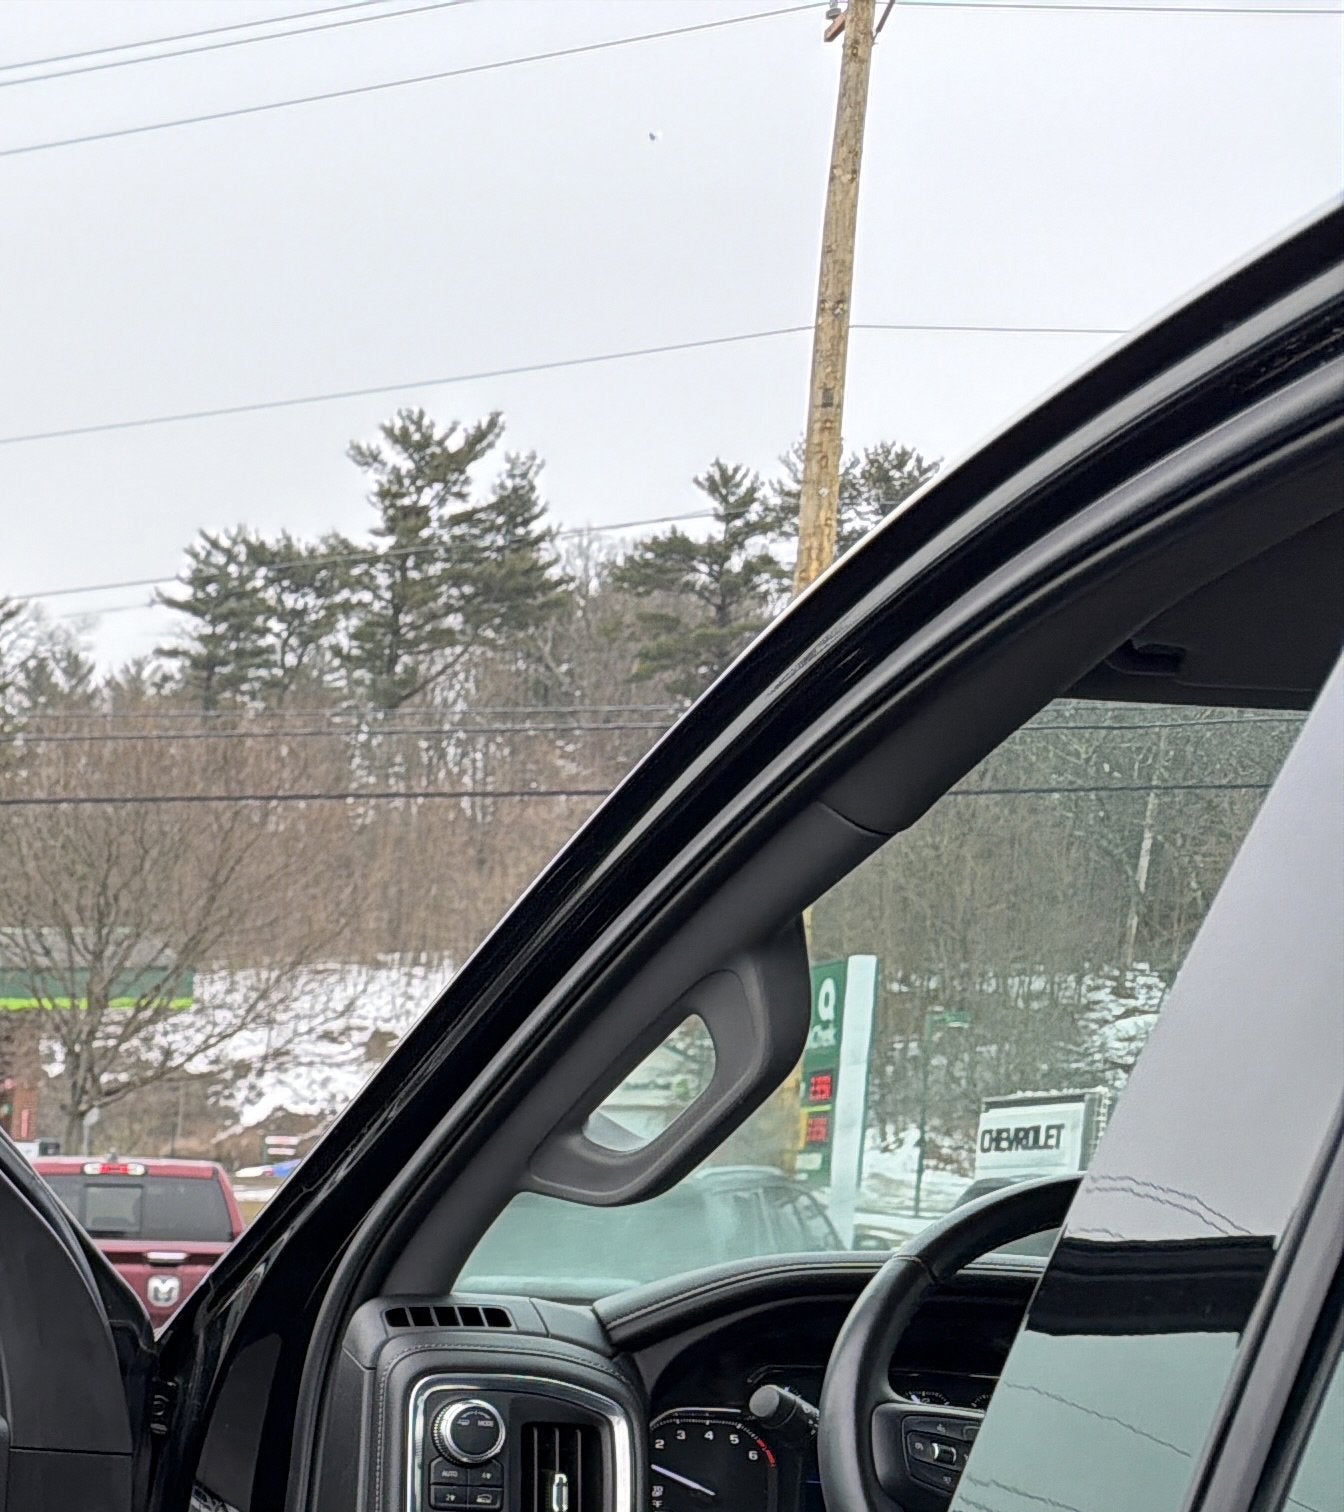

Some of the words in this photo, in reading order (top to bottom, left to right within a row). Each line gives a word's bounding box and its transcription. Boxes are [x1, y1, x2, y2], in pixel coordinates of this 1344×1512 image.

[980, 1123, 1065, 1153] CHEVROLET
[676, 1429, 686, 1440] 3
[704, 1430, 714, 1440] 4
[729, 1434, 740, 1444] 5
[654, 1439, 665, 1449] 2
[748, 1450, 758, 1460] 6
